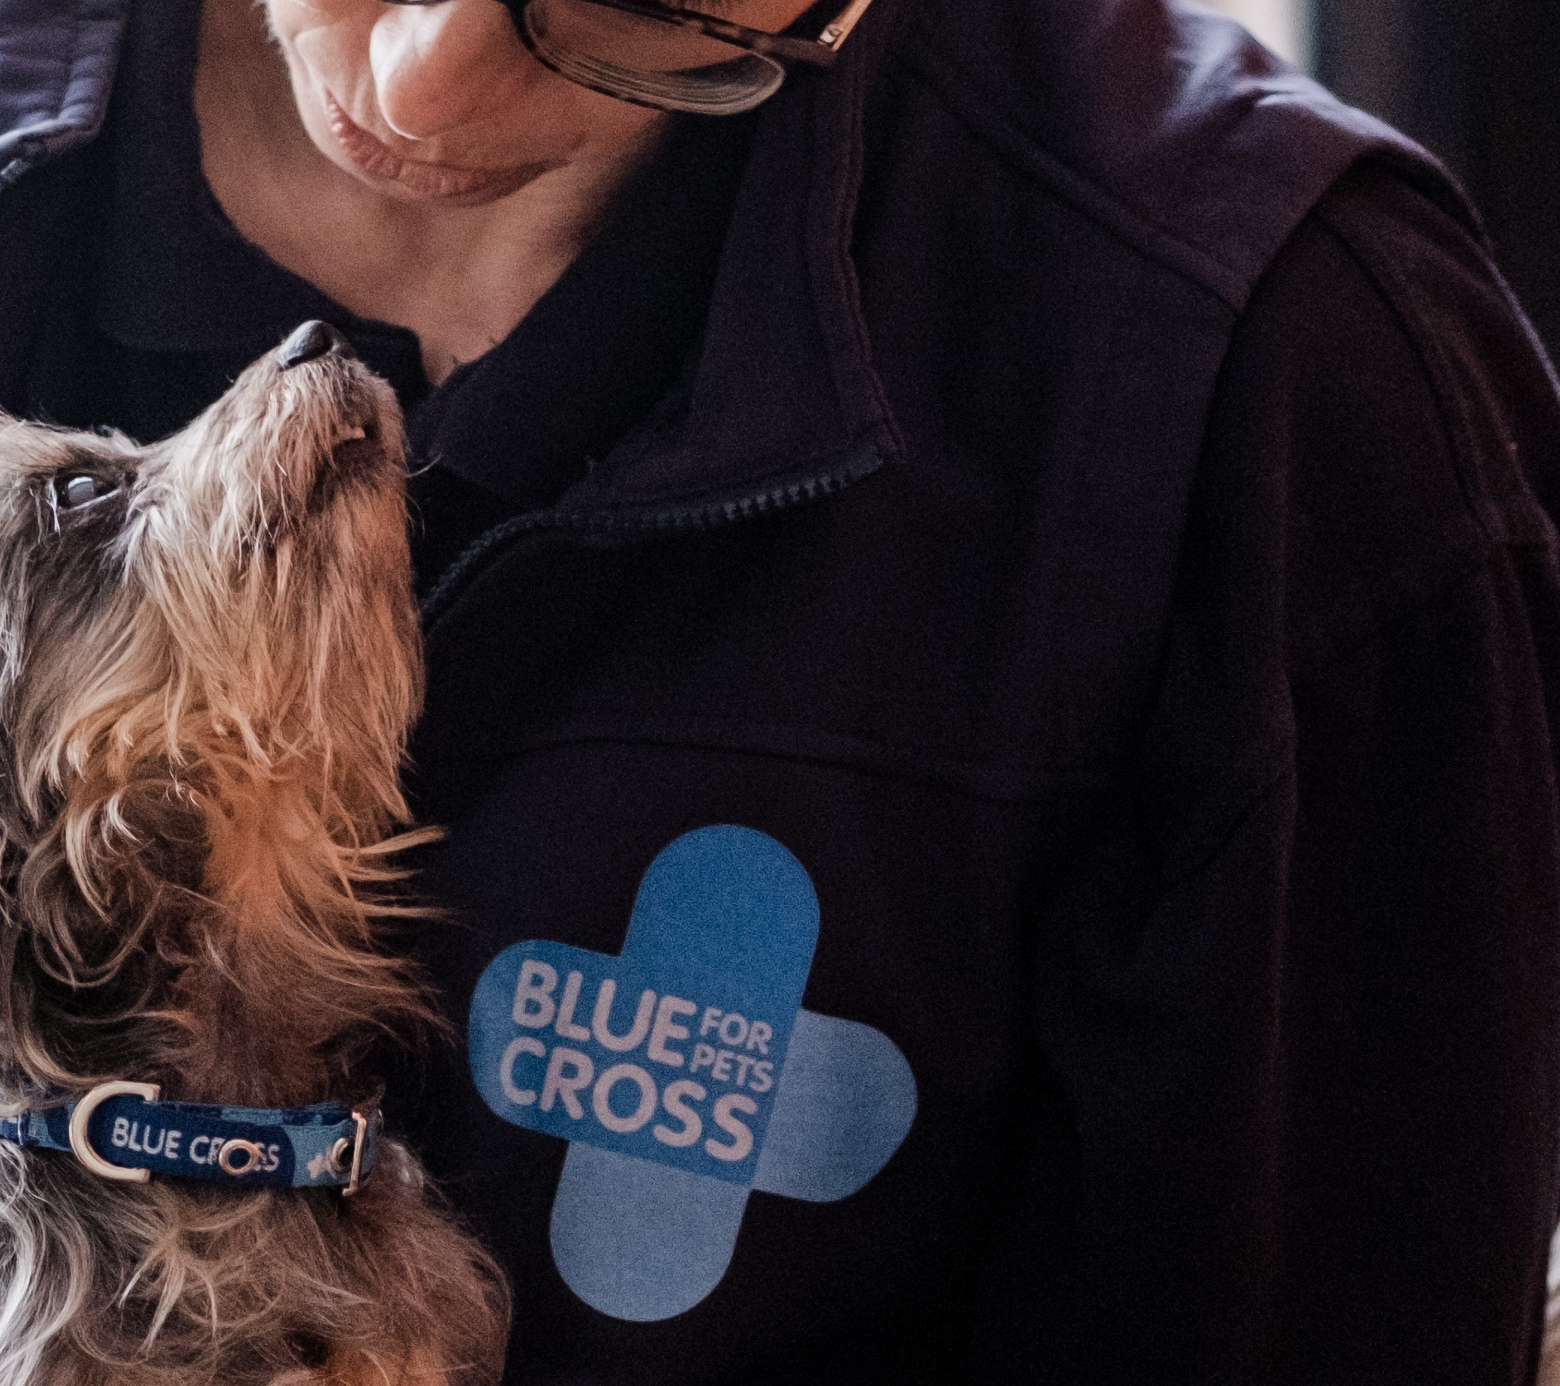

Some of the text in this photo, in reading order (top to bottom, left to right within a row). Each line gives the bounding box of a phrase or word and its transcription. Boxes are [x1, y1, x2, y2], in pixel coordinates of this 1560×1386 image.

[511, 959, 697, 1067] BLUE
[699, 1007, 773, 1054] FOR
[689, 1044, 774, 1094] PETS
[499, 1037, 758, 1162] CROSS
[111, 1116, 281, 1173] BLUE CRSS
